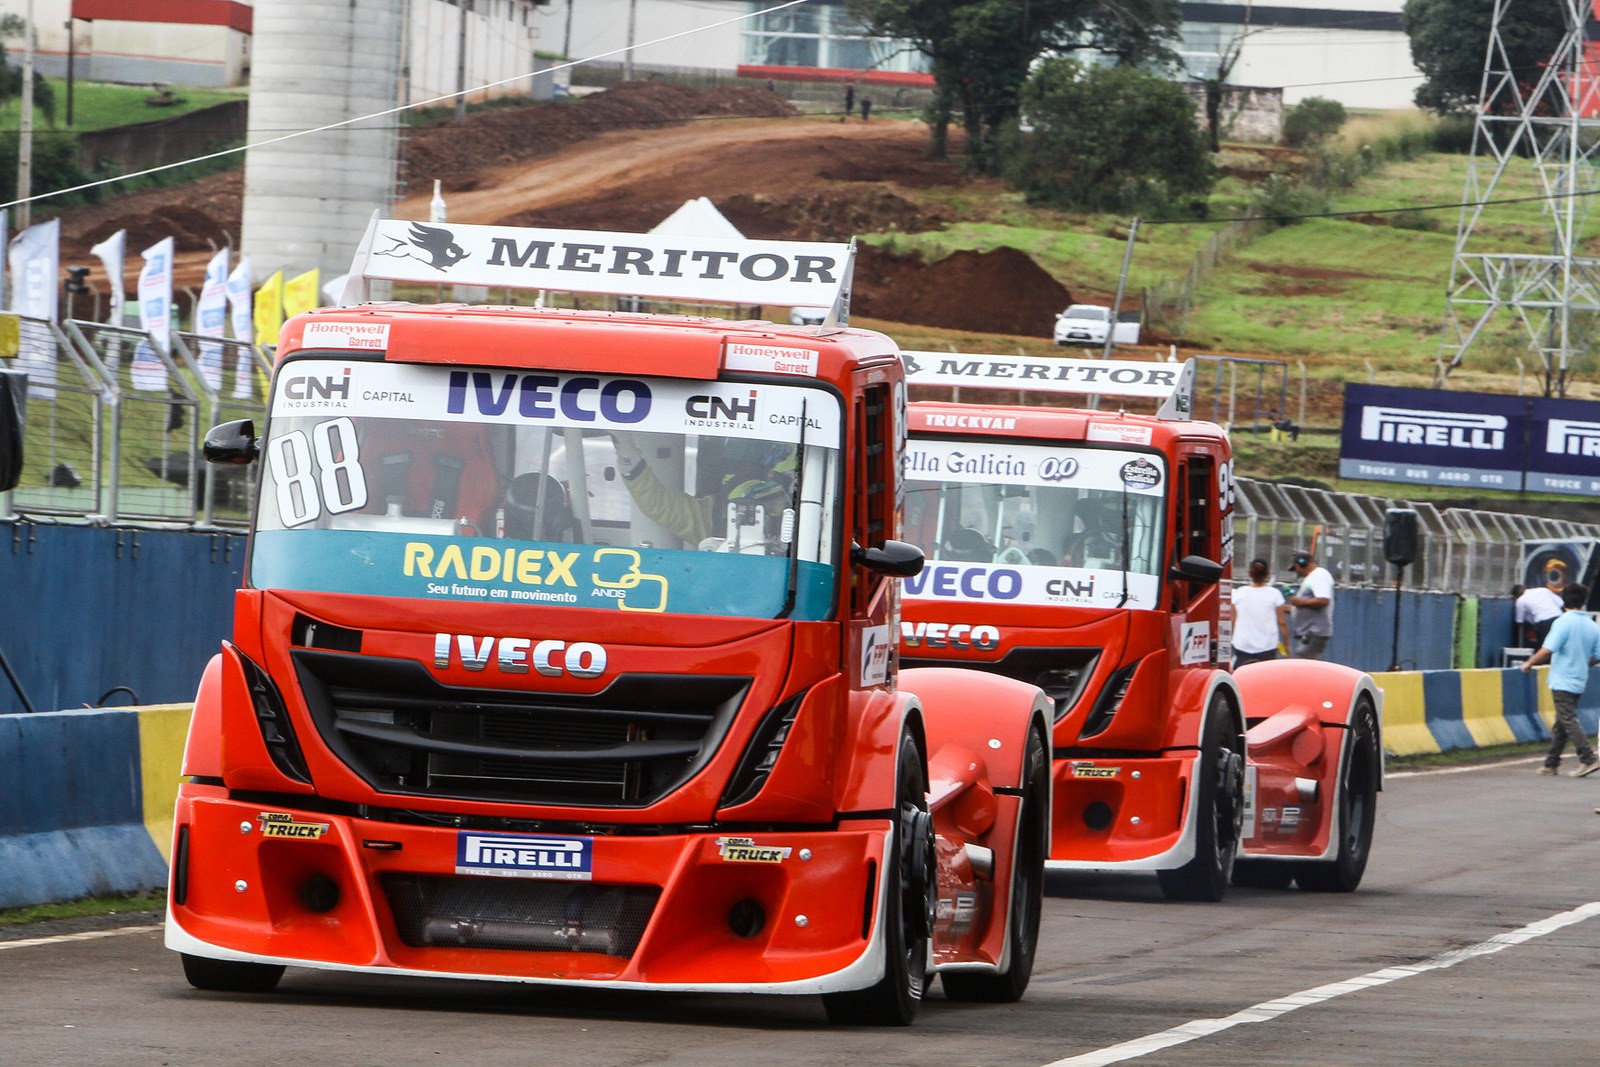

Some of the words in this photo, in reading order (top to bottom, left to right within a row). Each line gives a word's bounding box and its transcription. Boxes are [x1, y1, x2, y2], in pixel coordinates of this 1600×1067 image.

[486, 237, 836, 283] MERITOR
[310, 323, 385, 336] Honeywell
[349, 337, 382, 348] Garrett
[733, 345, 810, 361] Honeywell
[774, 361, 808, 374] Garrett
[936, 358, 1177, 386] MERITOR
[363, 391, 415, 403] CAPITAL
[447, 371, 652, 424] IVECO
[684, 419, 754, 430] INDUSTRIAL
[769, 414, 822, 429] CAPITAL
[926, 413, 1017, 430] TRUCKVAN
[1361, 405, 1508, 450] PIRELLI
[1546, 418, 1600, 457] PIR
[268, 415, 369, 529] 88
[905, 451, 940, 473] ella
[947, 451, 1026, 477] Galicia
[1358, 464, 1396, 476] TRUCK
[1405, 468, 1429, 479] BUS
[403, 542, 580, 587] RADIEX
[903, 565, 1022, 600] VECO
[427, 582, 448, 595] Seu
[451, 583, 487, 597] futuro
[490, 589, 508, 598] em
[511, 589, 577, 603] movimento
[591, 587, 627, 599] ANOS
[1103, 591, 1140, 602] CAPAL
[900, 621, 1000, 651] VECO
[434, 632, 607, 679] IVECO
[267, 824, 319, 838] TRUCK
[465, 835, 584, 868] PIRELLI
[728, 848, 781, 861] TRUCK
[465, 868, 491, 876] TRUCK
